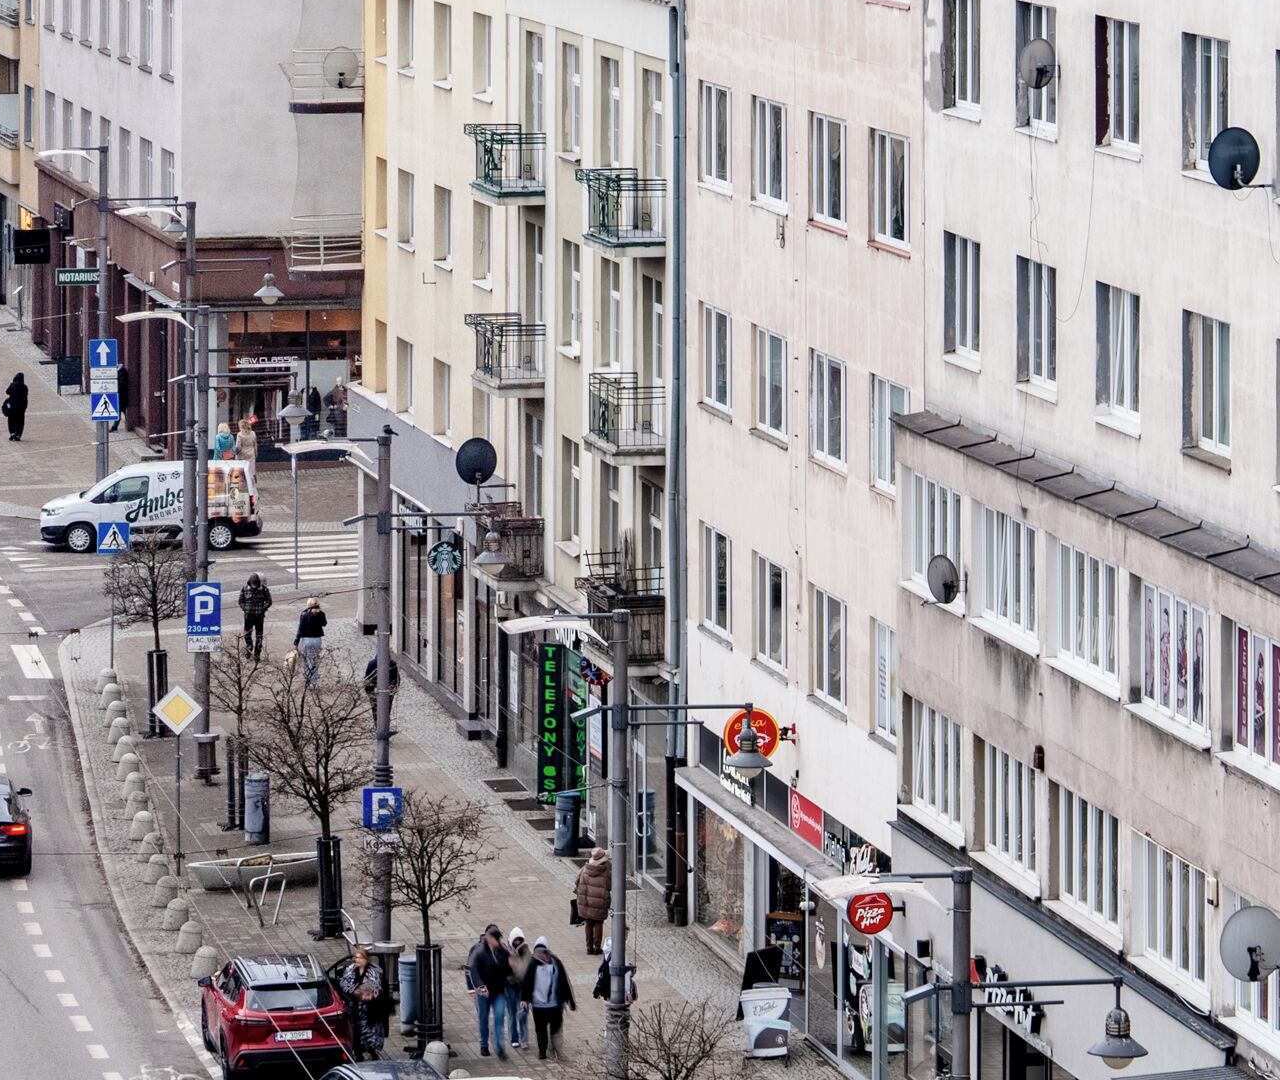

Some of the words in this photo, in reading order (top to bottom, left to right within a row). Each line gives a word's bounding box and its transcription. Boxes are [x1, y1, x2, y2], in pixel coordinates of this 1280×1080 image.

[125, 487, 184, 522] Ambe
[194, 595, 214, 623] P
[543, 646, 557, 757] TELEFONY
[372, 792, 395, 824] P
[855, 906, 885, 922] Pizza
[860, 914, 885, 929] Hut
